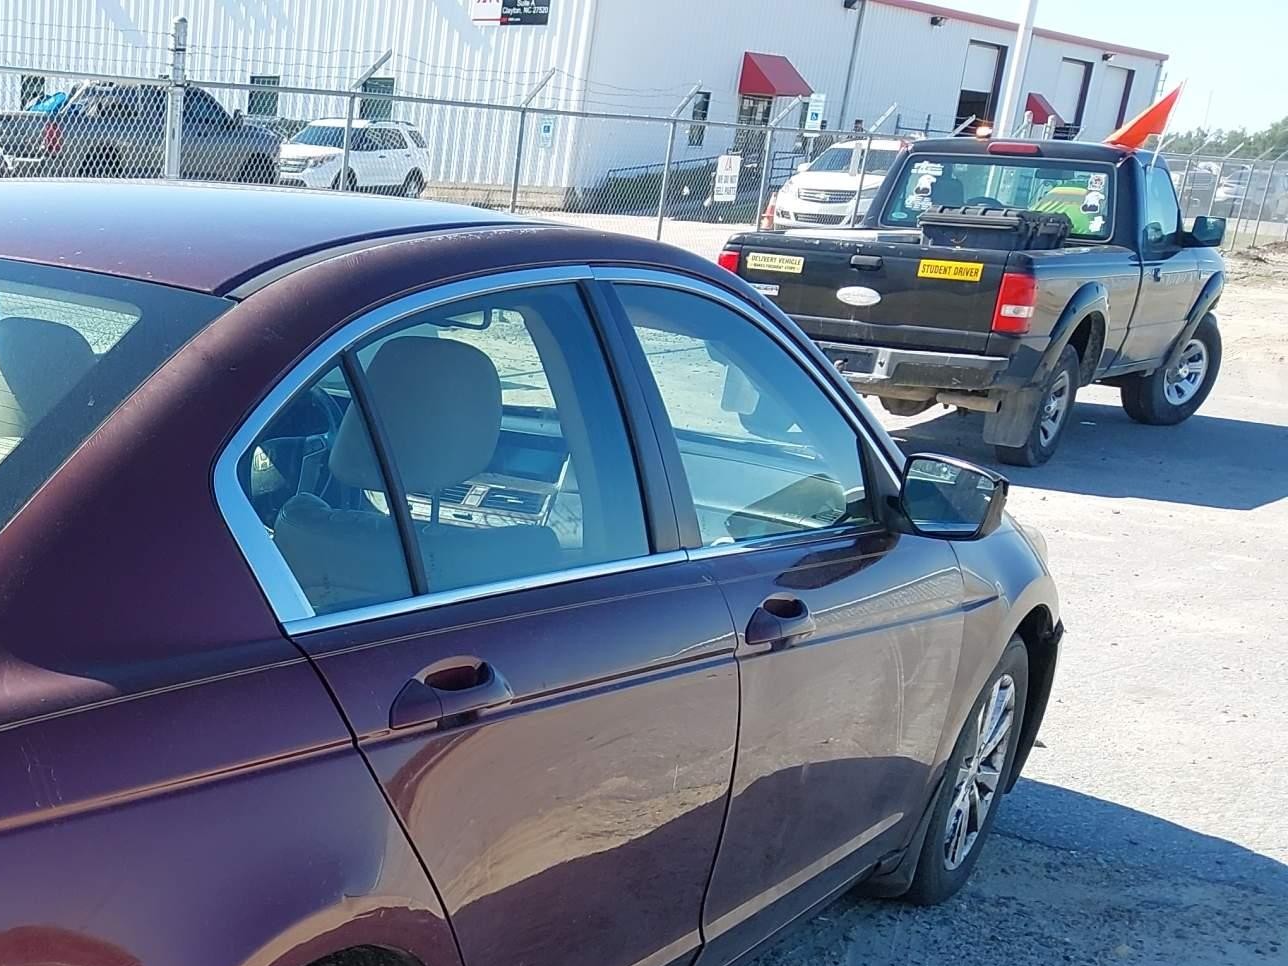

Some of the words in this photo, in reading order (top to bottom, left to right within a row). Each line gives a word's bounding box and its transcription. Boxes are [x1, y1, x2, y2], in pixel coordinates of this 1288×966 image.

[751, 255, 777, 263] DELIVERY
[778, 257, 801, 266] VEHICLE
[921, 264, 952, 275] STUDENT
[953, 266, 979, 277] DRIVER
